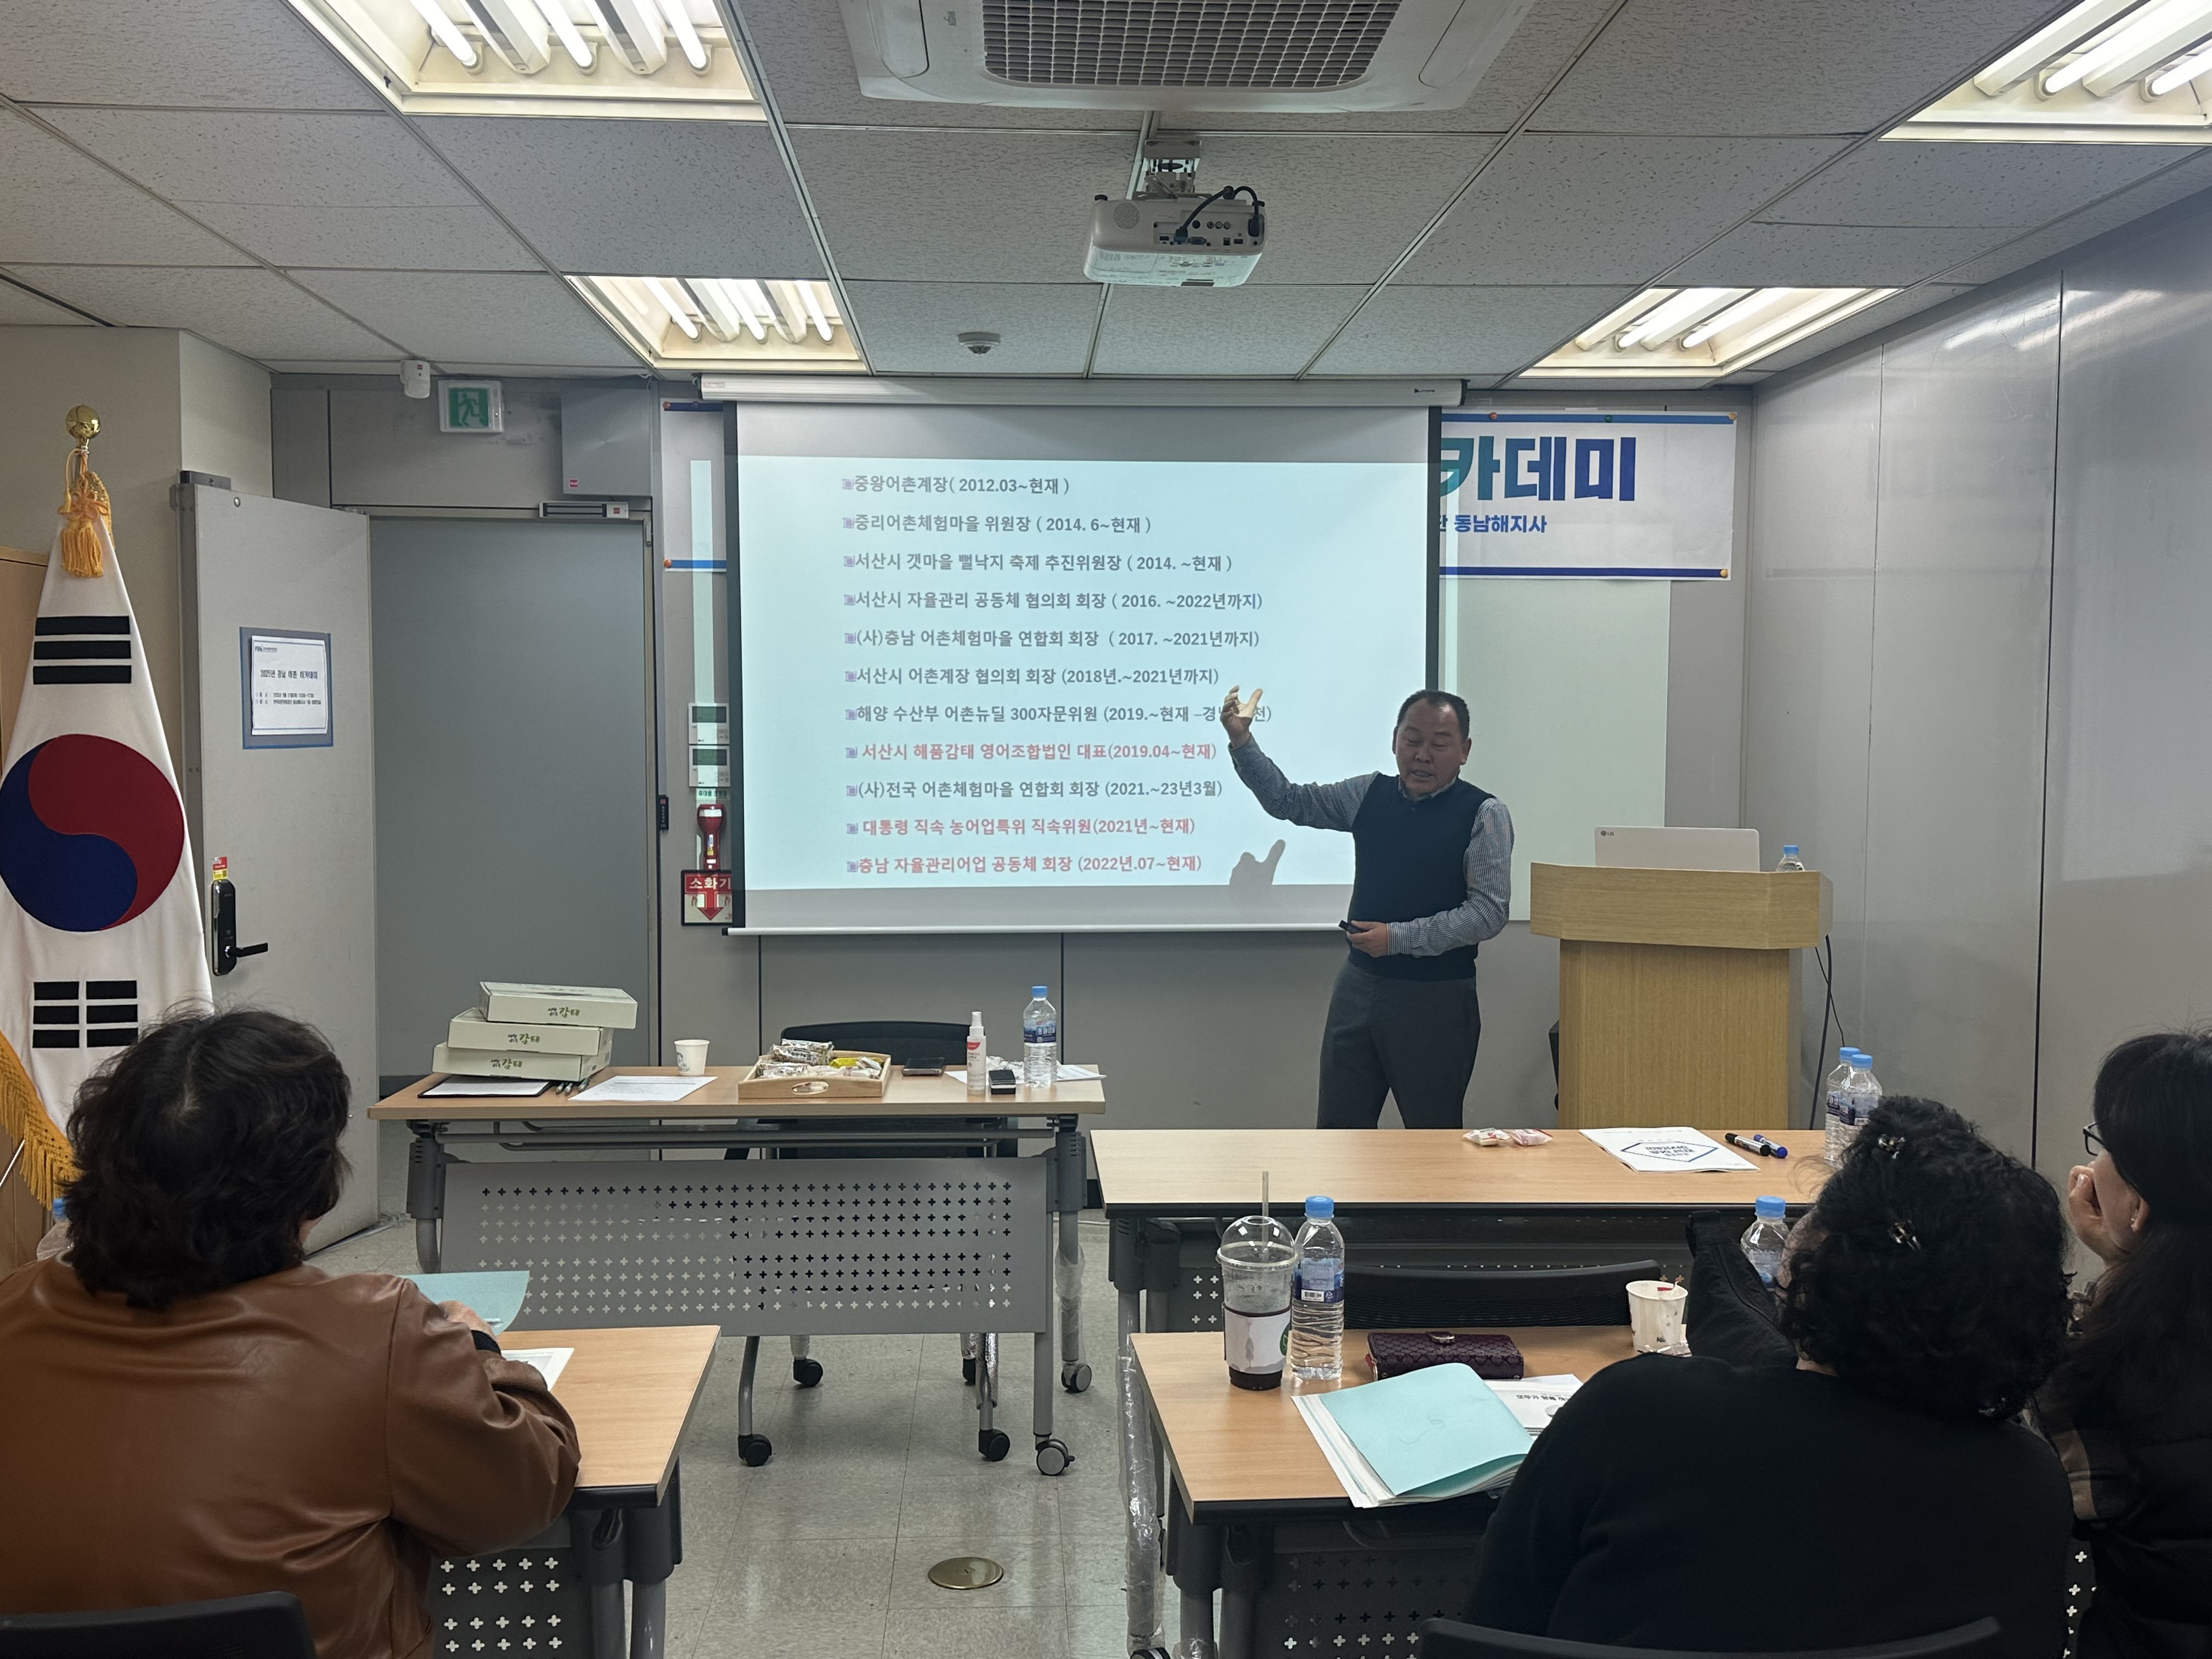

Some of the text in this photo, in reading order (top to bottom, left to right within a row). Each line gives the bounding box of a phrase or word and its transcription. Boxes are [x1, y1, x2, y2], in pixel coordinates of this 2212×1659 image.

[855, 514, 980, 532] 중리어촌체험마을
[984, 516, 1031, 533] 위원장
[1454, 514, 1547, 533] 동남해지사
[855, 552, 901, 571] 서산시
[906, 552, 953, 571] 갯마을
[958, 554, 1003, 571] 뻘낙지
[1009, 554, 1039, 571] 축제
[1045, 554, 1122, 572] 추진위원장
[855, 590, 901, 609] 서산시
[907, 591, 968, 609] 자율관리
[974, 591, 1020, 609] 공동체
[1025, 592, 1070, 610] 협의회
[1075, 592, 1107, 610] 회장
[857, 629, 916, 646] (사)충남
[921, 629, 1013, 647] 어촌체험마을
[1018, 630, 1063, 647] 연합회
[1068, 630, 1099, 647] 회장
[856, 667, 902, 685] 서산시
[909, 667, 970, 685] 어촌계장
[975, 668, 1020, 685] 협의회
[1025, 668, 1057, 685] 회장
[856, 705, 888, 723] 해양
[893, 705, 939, 723] 수산부
[944, 706, 1005, 723] 어촌뉴딜
[1010, 706, 1098, 723] 300자문위원
[862, 743, 907, 760] 서산시
[913, 743, 974, 760] 해품감태
[980, 743, 1071, 760] 영어조합법인
[858, 781, 917, 799] (사)전국
[922, 781, 1014, 798] 어촌체험마을
[1019, 781, 1064, 798] 연합회
[1069, 781, 1100, 798] 회장
[863, 819, 908, 836] 대통령
[914, 819, 945, 836] 직속
[949, 819, 1025, 836] 농어업특위
[859, 857, 889, 874] 충남
[894, 856, 986, 873] 자율관리어업
[991, 855, 1036, 873] 공동체
[1042, 856, 1073, 872] 회장
[689, 877, 731, 890] 소화기
